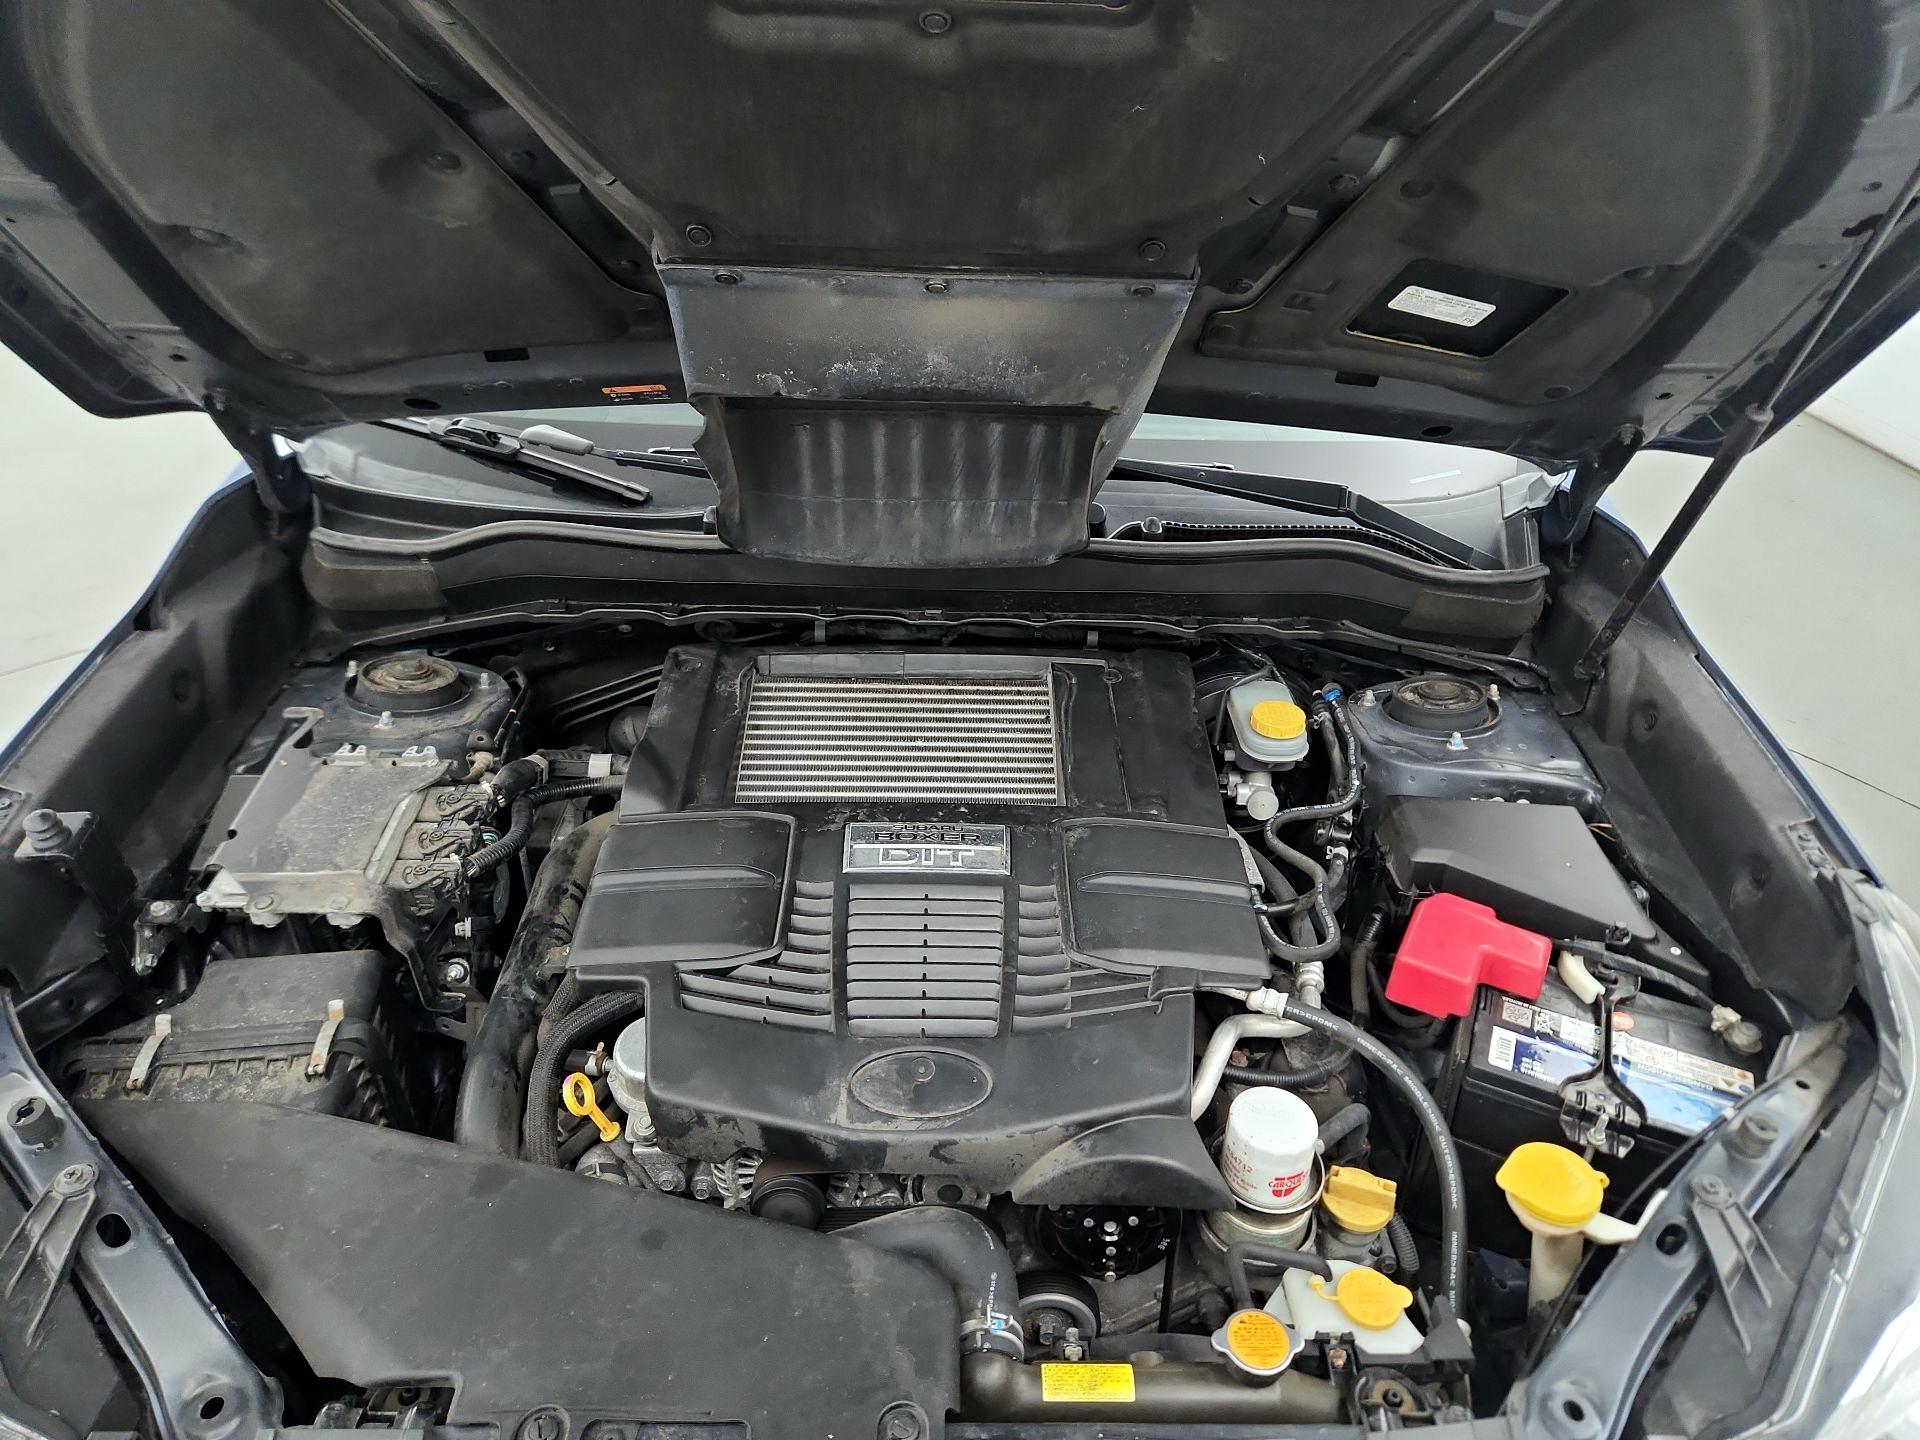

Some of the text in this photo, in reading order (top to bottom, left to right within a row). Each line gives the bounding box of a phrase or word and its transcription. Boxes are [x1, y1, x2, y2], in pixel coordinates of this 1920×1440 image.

[892, 824, 964, 832] SUBARU
[874, 832, 982, 843] BOXER
[879, 847, 976, 866] DIT
